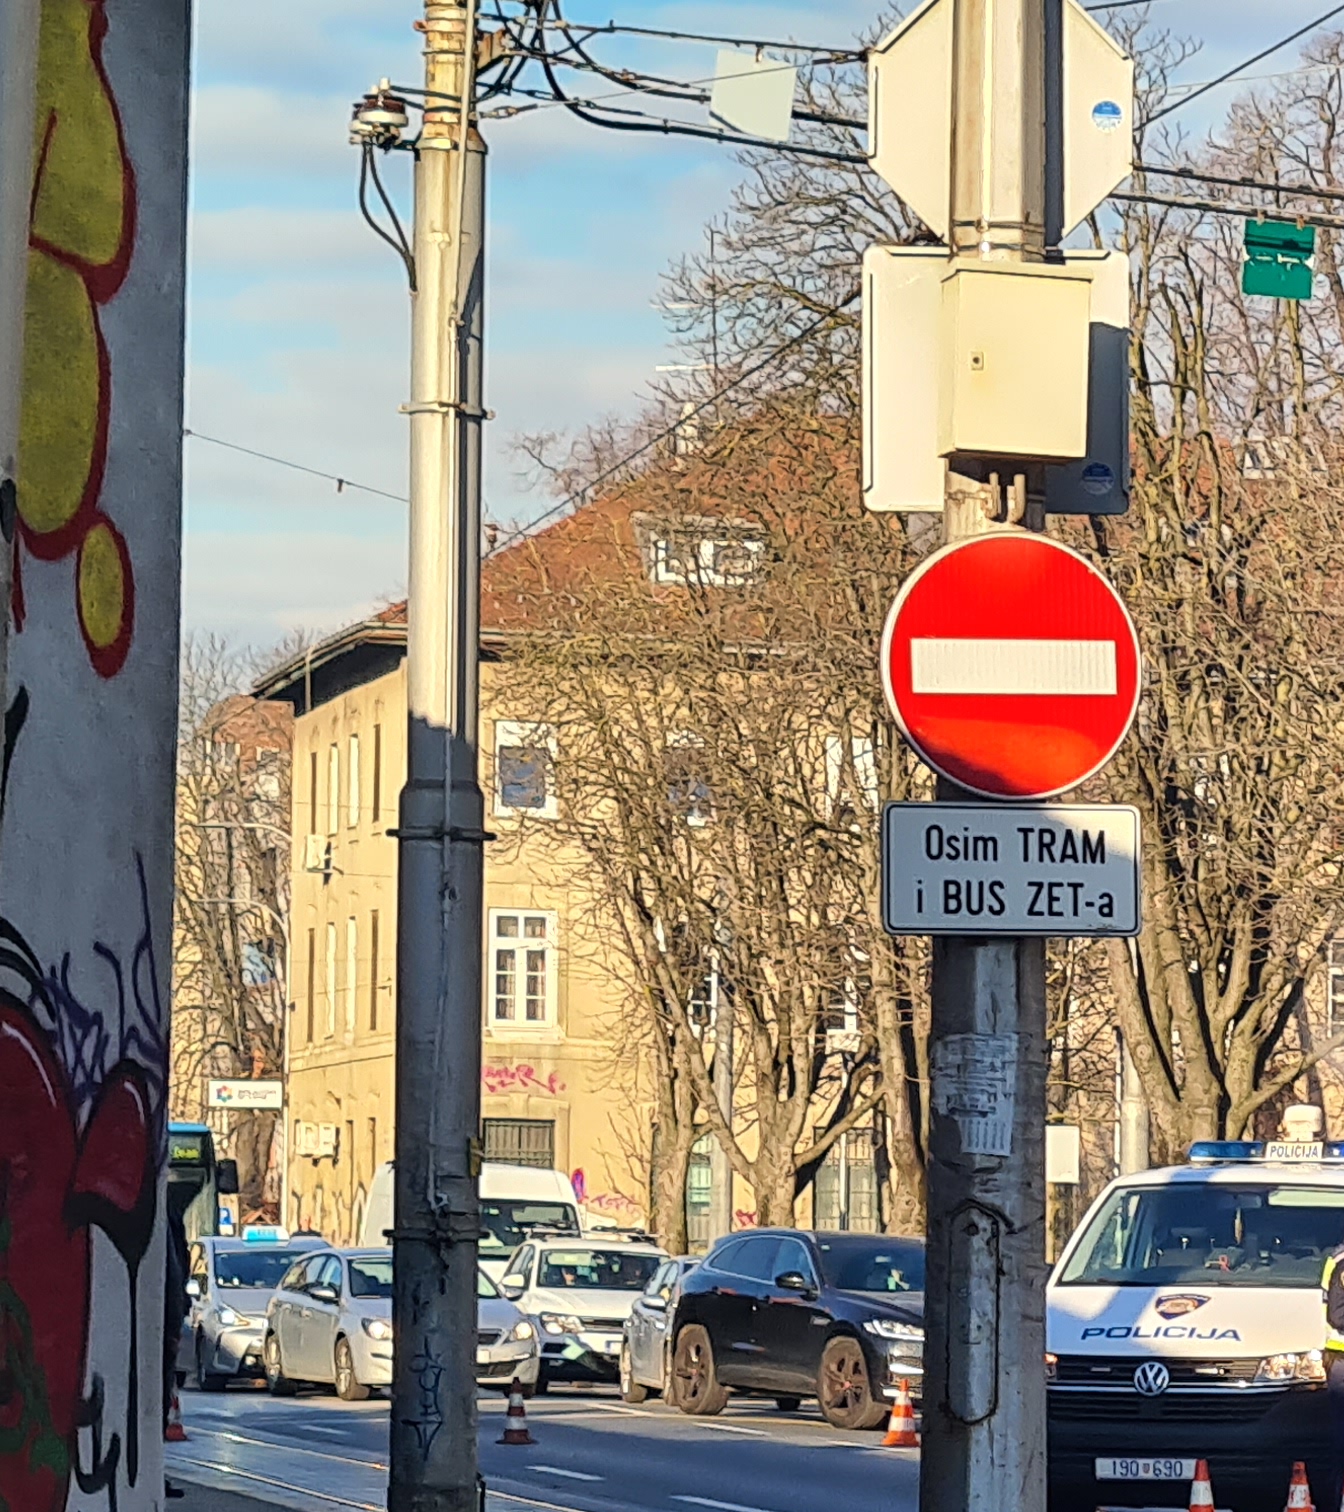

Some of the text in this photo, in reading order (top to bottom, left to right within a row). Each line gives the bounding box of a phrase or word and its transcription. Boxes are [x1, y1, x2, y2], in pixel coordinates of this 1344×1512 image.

[925, 824, 1106, 864] Osim TRAM
[915, 879, 1114, 918] i BUS ZET-a
[1269, 1145, 1319, 1159] POLICIJA
[1081, 1326, 1242, 1342] POLICIJA
[1112, 1460, 1184, 1478] 190 690
